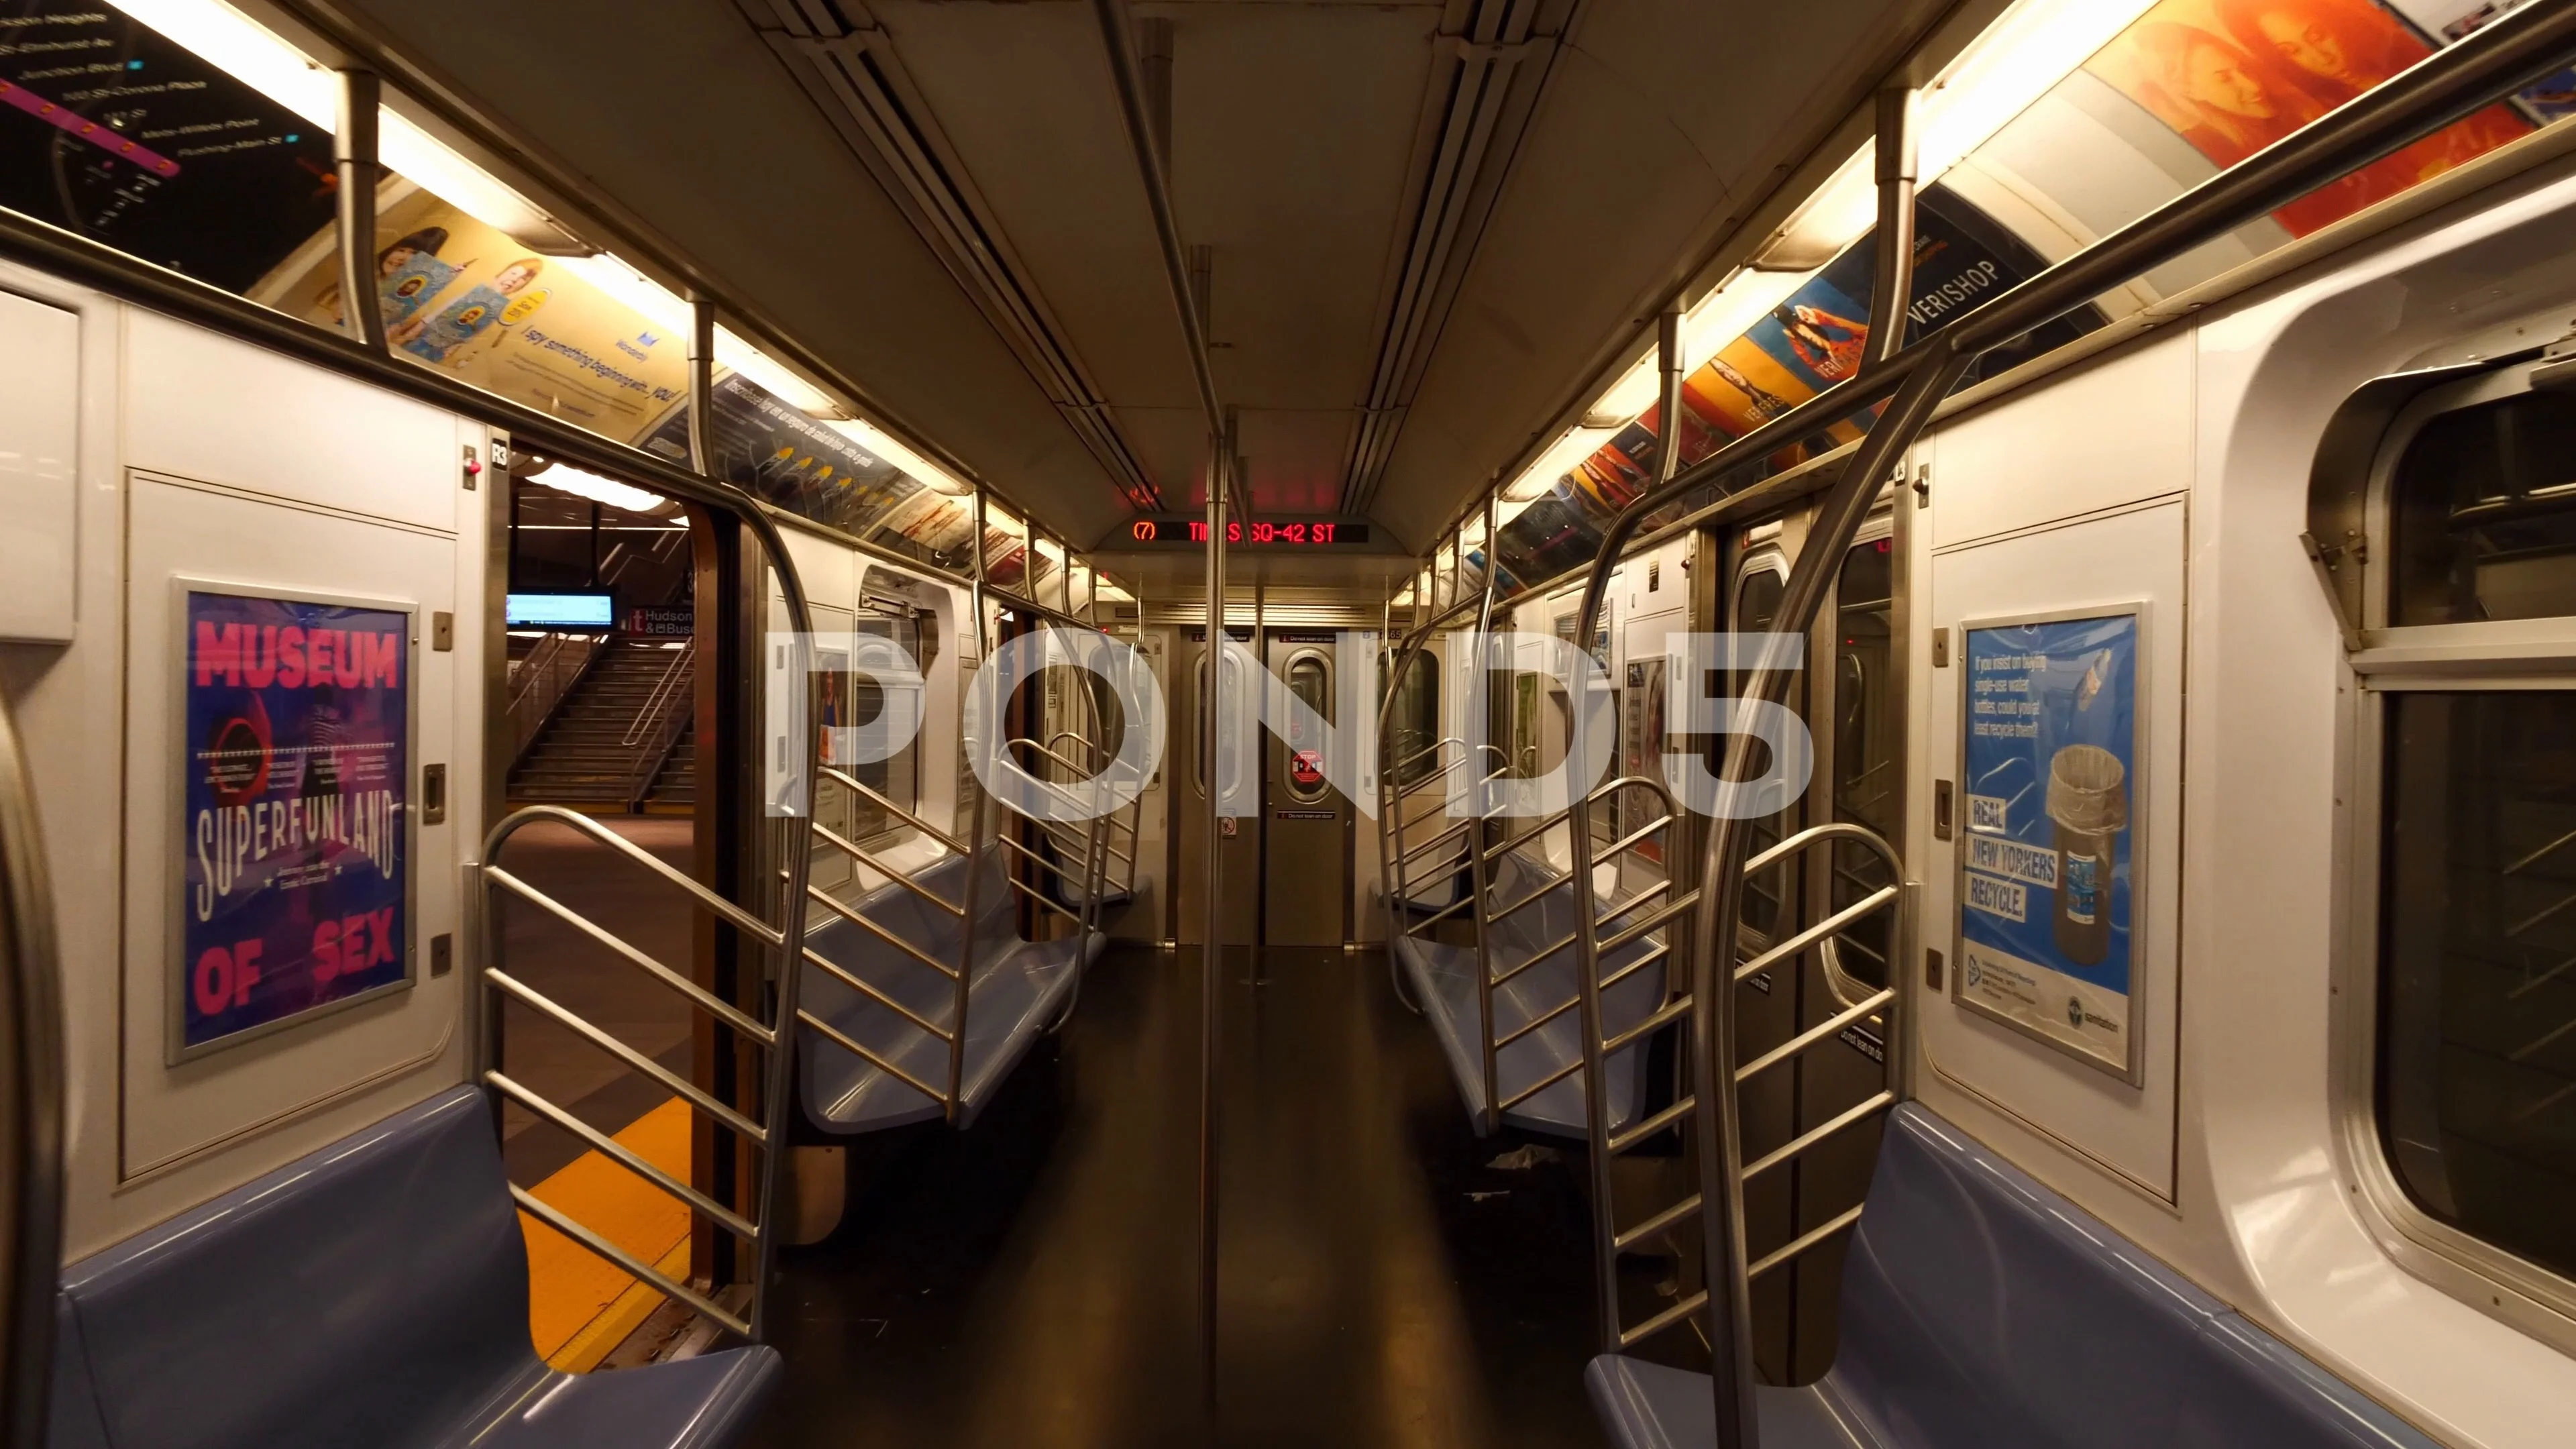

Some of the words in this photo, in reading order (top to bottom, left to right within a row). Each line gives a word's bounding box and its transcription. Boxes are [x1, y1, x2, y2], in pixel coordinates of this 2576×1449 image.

[1907, 261, 1999, 324] VERISHOP
[525, 329, 549, 345] spy
[544, 340, 594, 368] something
[590, 359, 633, 388] beginning
[493, 442, 507, 466] R3
[1895, 461, 1906, 482] L3
[1312, 524, 1336, 542] ST
[645, 610, 693, 622] Hudson
[195, 620, 398, 689] MUSEUM
[1980, 657, 1993, 674] you
[1992, 654, 2011, 670] insist
[2011, 657, 2022, 669] on
[1975, 677, 2007, 696] single-use
[2007, 677, 2029, 692] water
[1989, 720, 2015, 740] recycle
[1973, 800, 2003, 828] REAL
[197, 790, 394, 922] SUPERFUNLAND
[1972, 839, 1999, 869] NEW
[2000, 844, 2055, 883] YORKERS
[1970, 877, 2023, 917] RECYCLE.
[194, 938, 264, 1016] OF
[313, 906, 396, 982] SEX
[1856, 1034, 1868, 1053] lean
